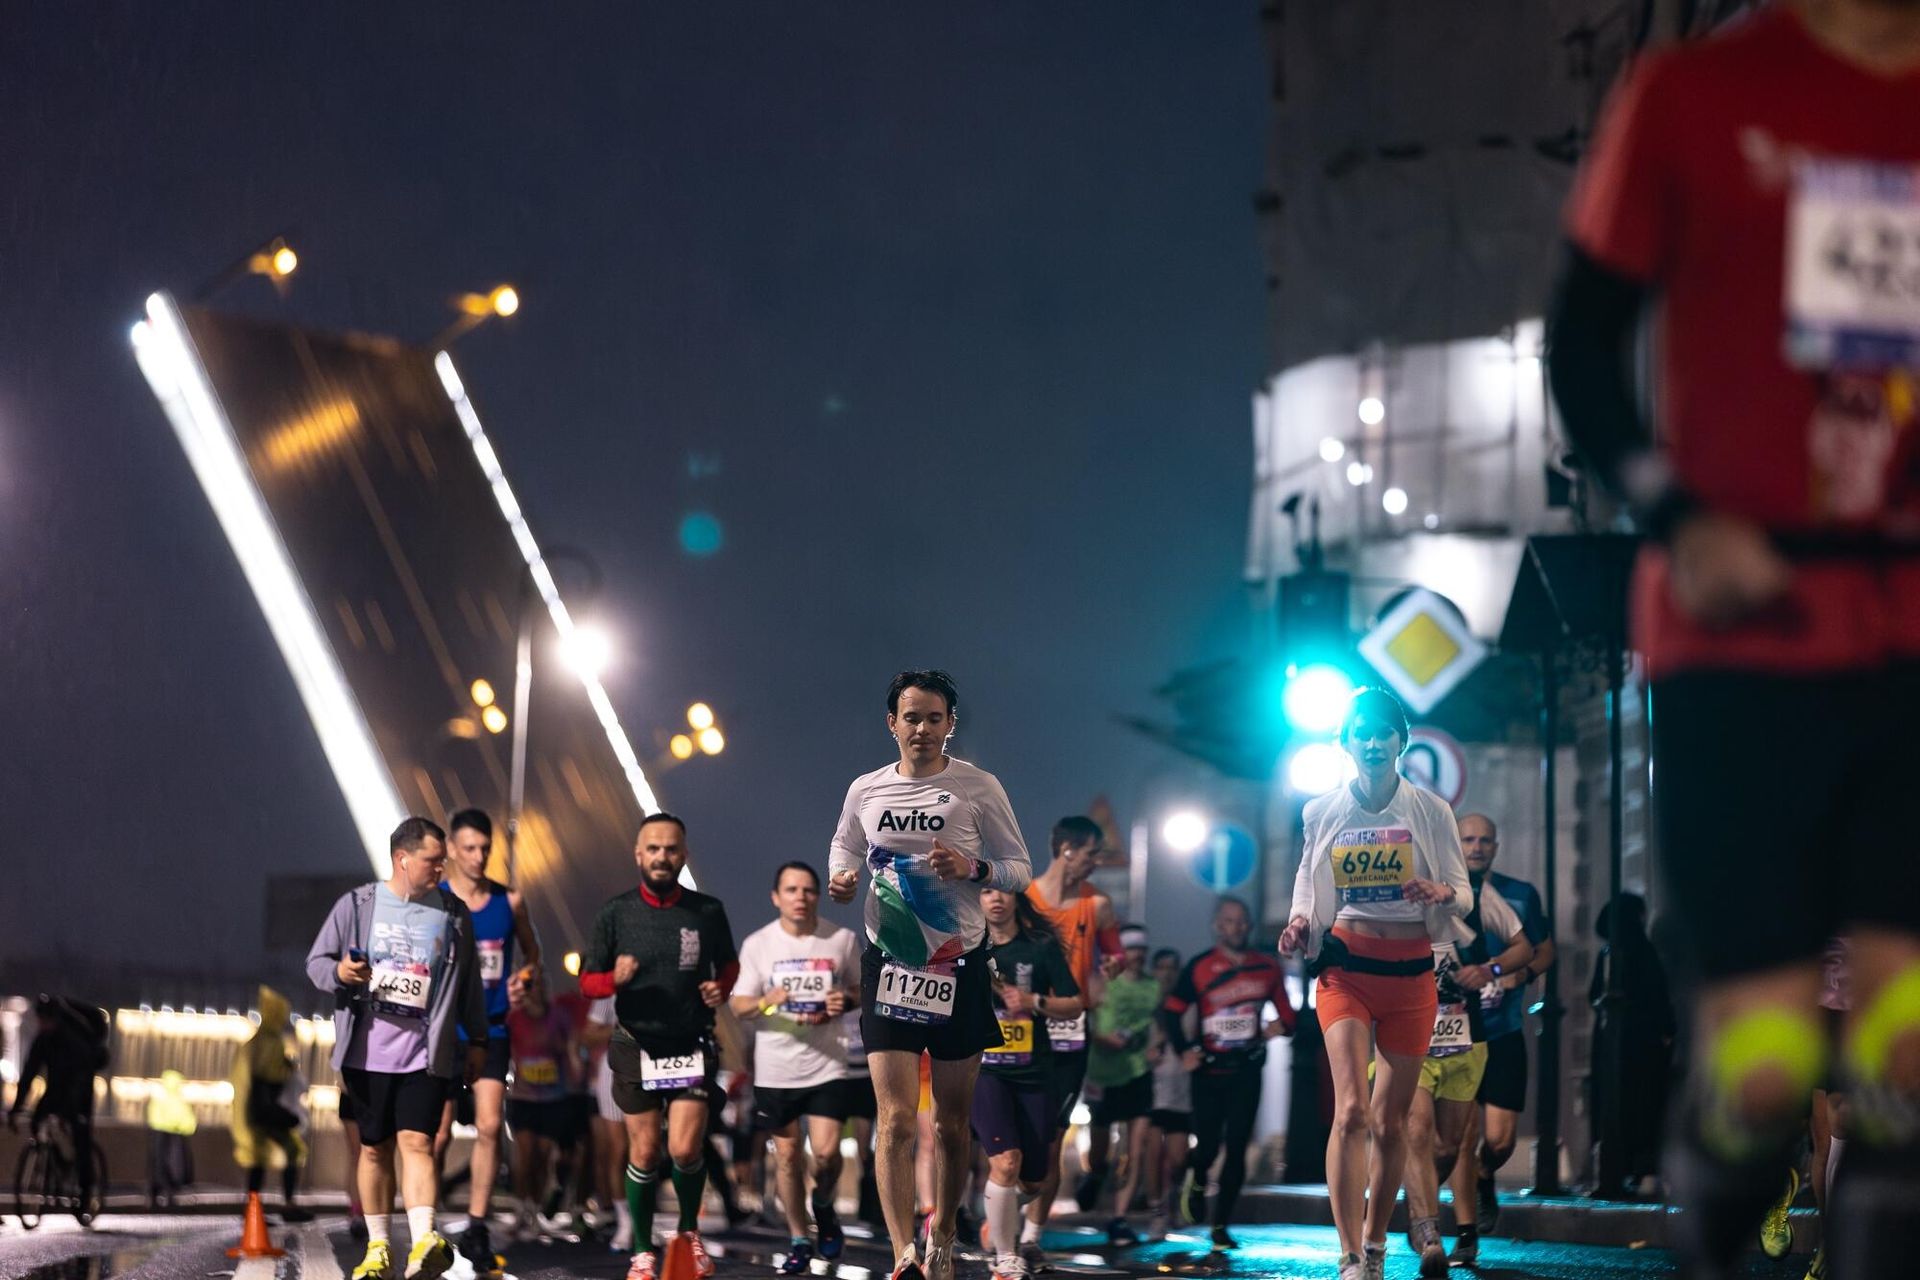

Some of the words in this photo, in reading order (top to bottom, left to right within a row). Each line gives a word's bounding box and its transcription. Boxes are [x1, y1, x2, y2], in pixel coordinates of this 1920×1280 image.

[877, 809, 945, 832] Avito
[1342, 849, 1403, 874] 6944
[1348, 873, 1400, 883] АЛЕКСАНДРА
[377, 975, 422, 996] 4438
[782, 976, 824, 992] 8748
[884, 971, 953, 1002] 11708
[900, 996, 929, 1008] СТЕПАН
[1003, 1025, 1025, 1042] 50
[654, 1055, 696, 1071] 1262
